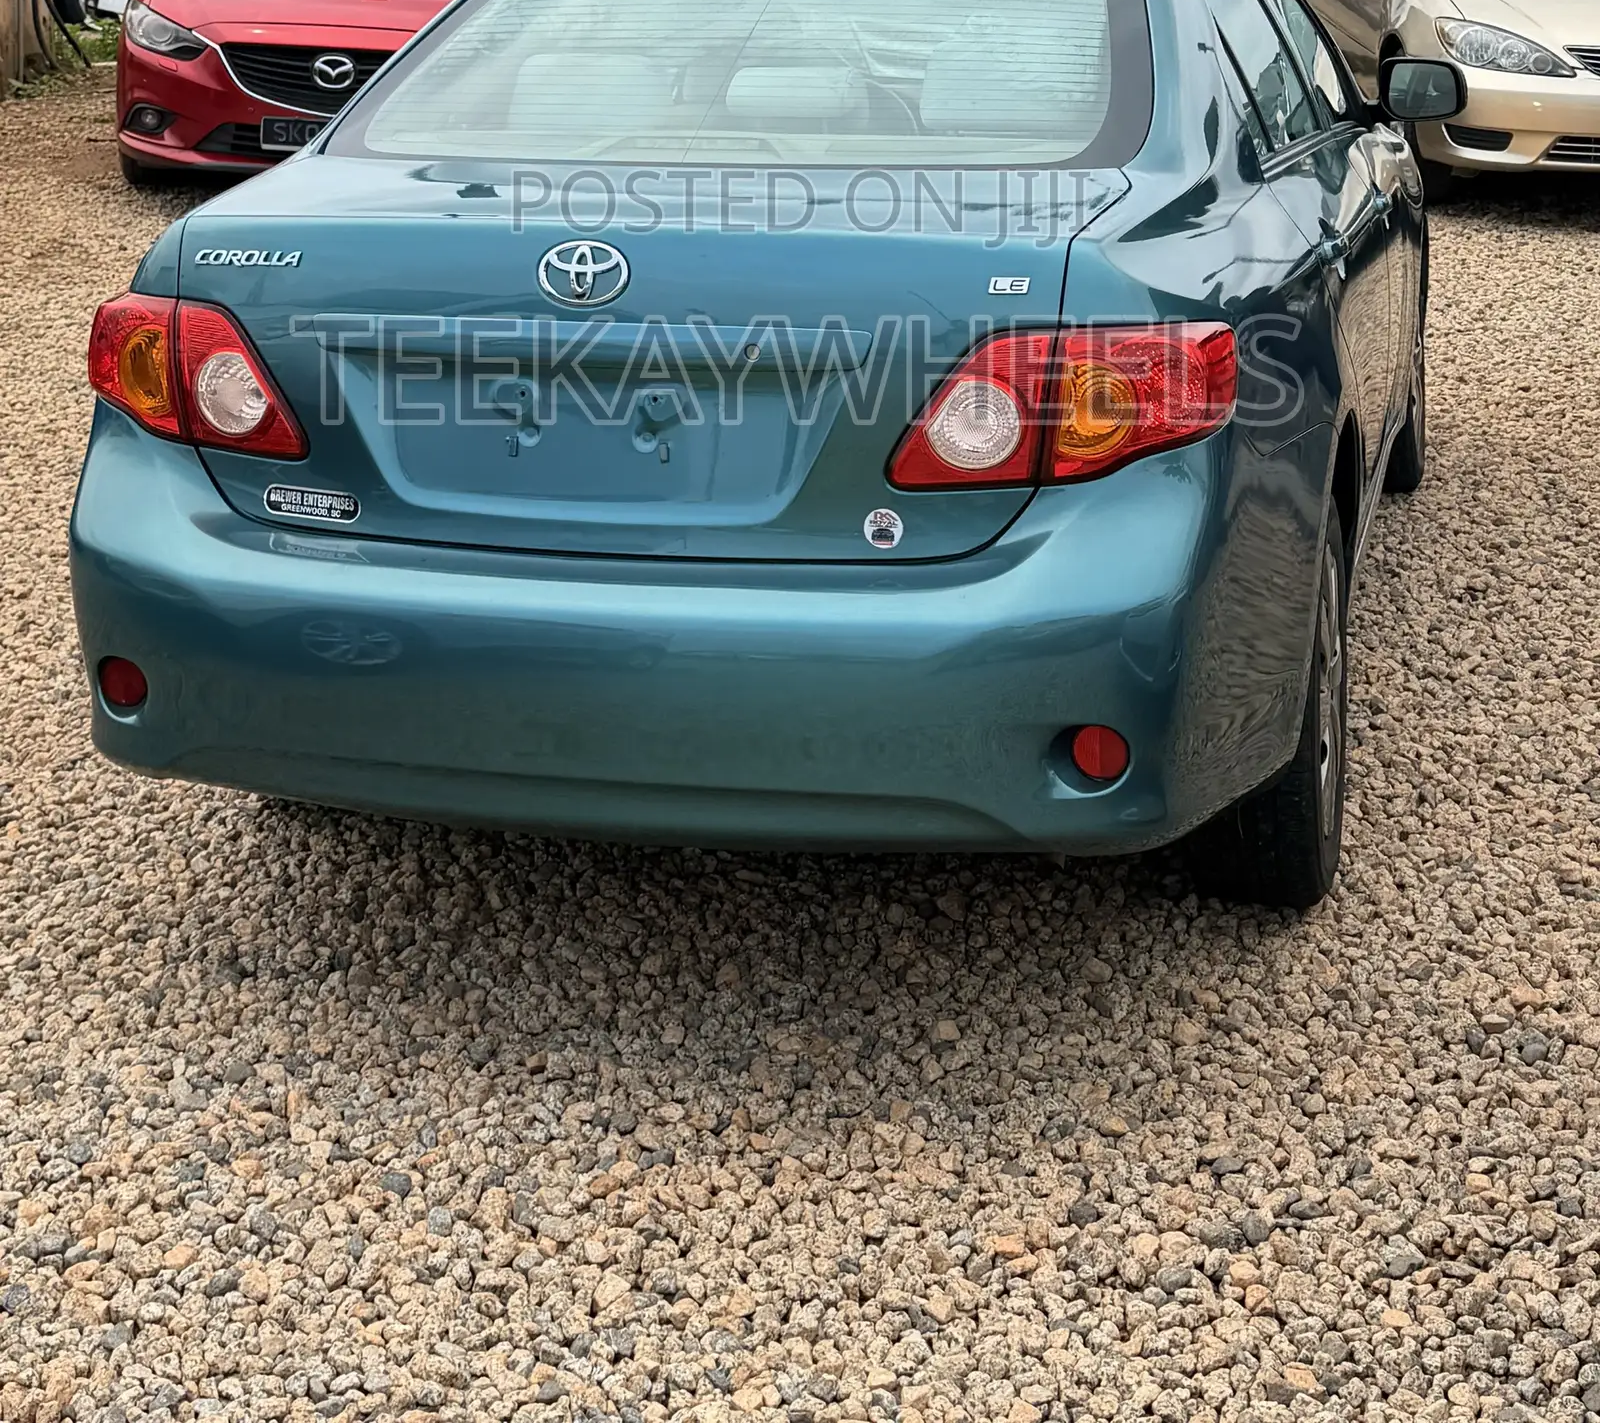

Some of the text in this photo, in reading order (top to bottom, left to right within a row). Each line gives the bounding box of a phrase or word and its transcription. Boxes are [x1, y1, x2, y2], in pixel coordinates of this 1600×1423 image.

[195, 249, 303, 267] COROLLA
[991, 278, 1028, 293] LE
[270, 489, 355, 512] BREWER ENTERPRISES
[330, 509, 342, 518] SC
